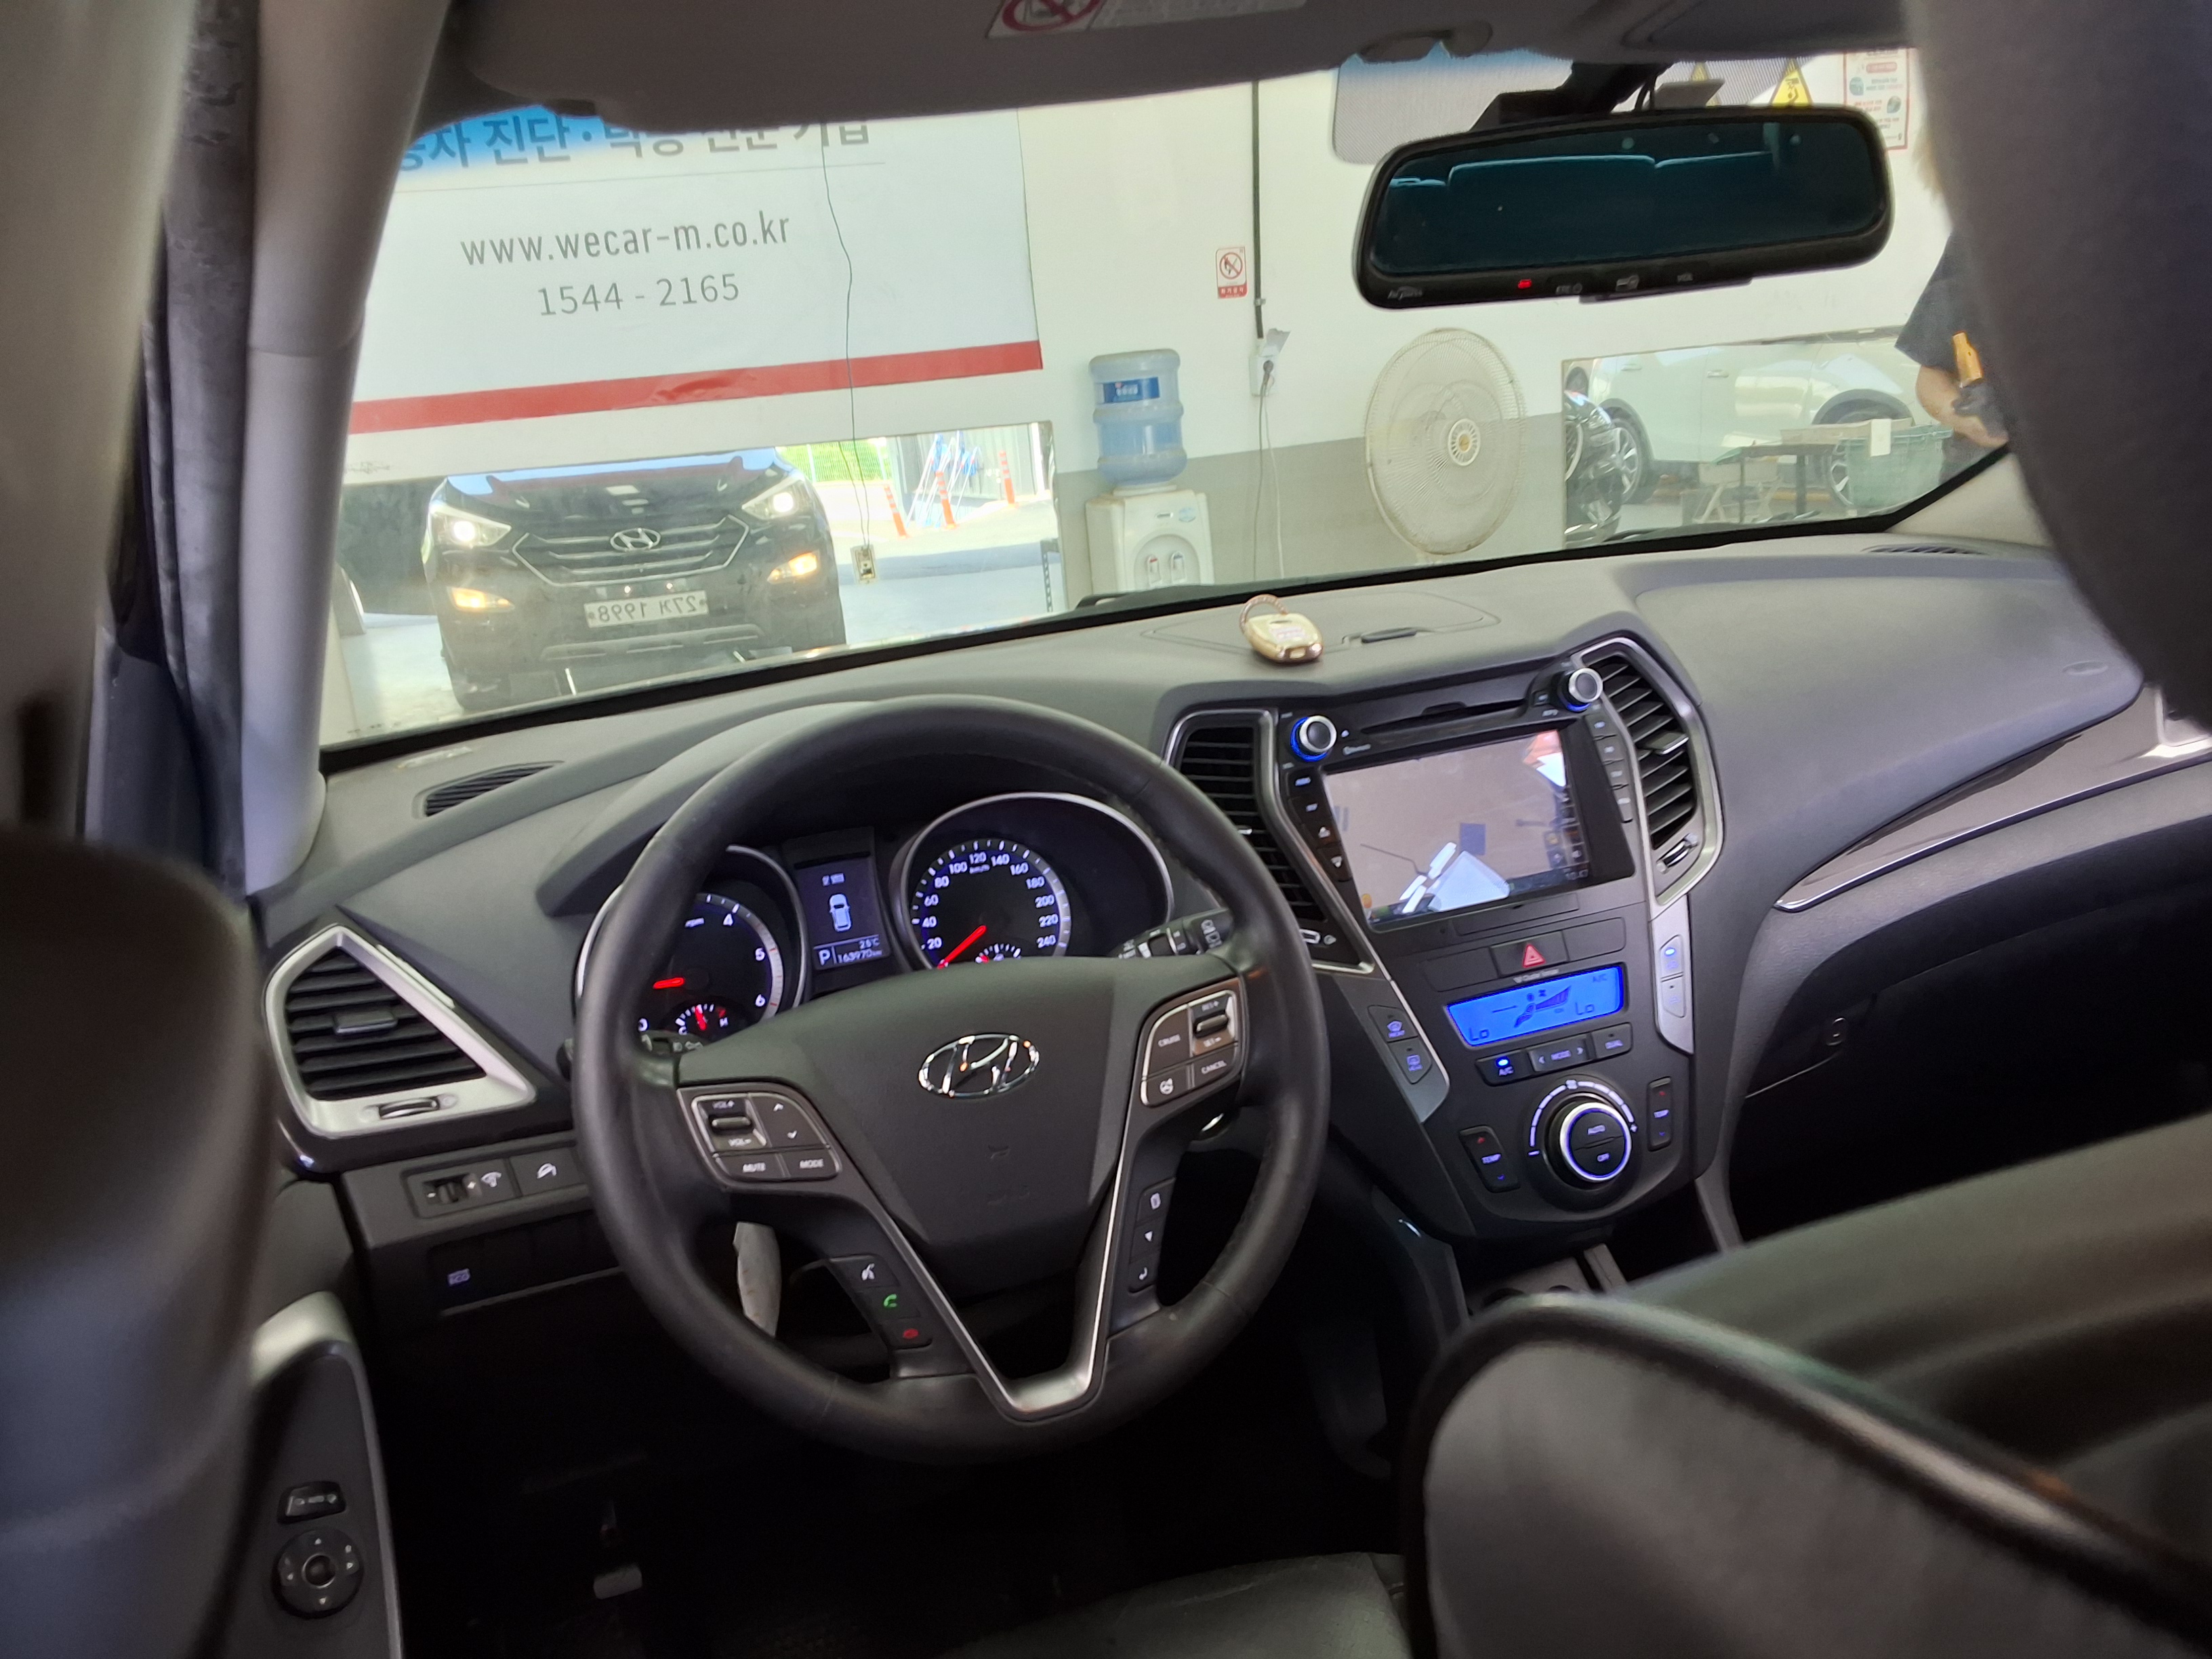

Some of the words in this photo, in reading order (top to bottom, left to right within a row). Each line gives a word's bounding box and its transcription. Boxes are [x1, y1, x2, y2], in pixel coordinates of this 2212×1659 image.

[459, 210, 790, 266] www.wecar-m.co.kr
[537, 282, 623, 316] 1544
[656, 273, 740, 306] 2165
[969, 852, 987, 864] 120
[991, 853, 1010, 866] 140
[949, 861, 968, 874] 100
[1010, 862, 1029, 876] 160
[934, 876, 949, 888] 80
[1025, 876, 1045, 889] 180
[924, 894, 939, 907] 60
[1035, 895, 1054, 908] 200
[722, 913, 733, 926] 4
[922, 916, 937, 928] 40
[1038, 914, 1059, 928] 220
[926, 937, 942, 950] 20
[1036, 935, 1057, 948] 240
[818, 949, 831, 966] P
[755, 994, 766, 1007] 6
